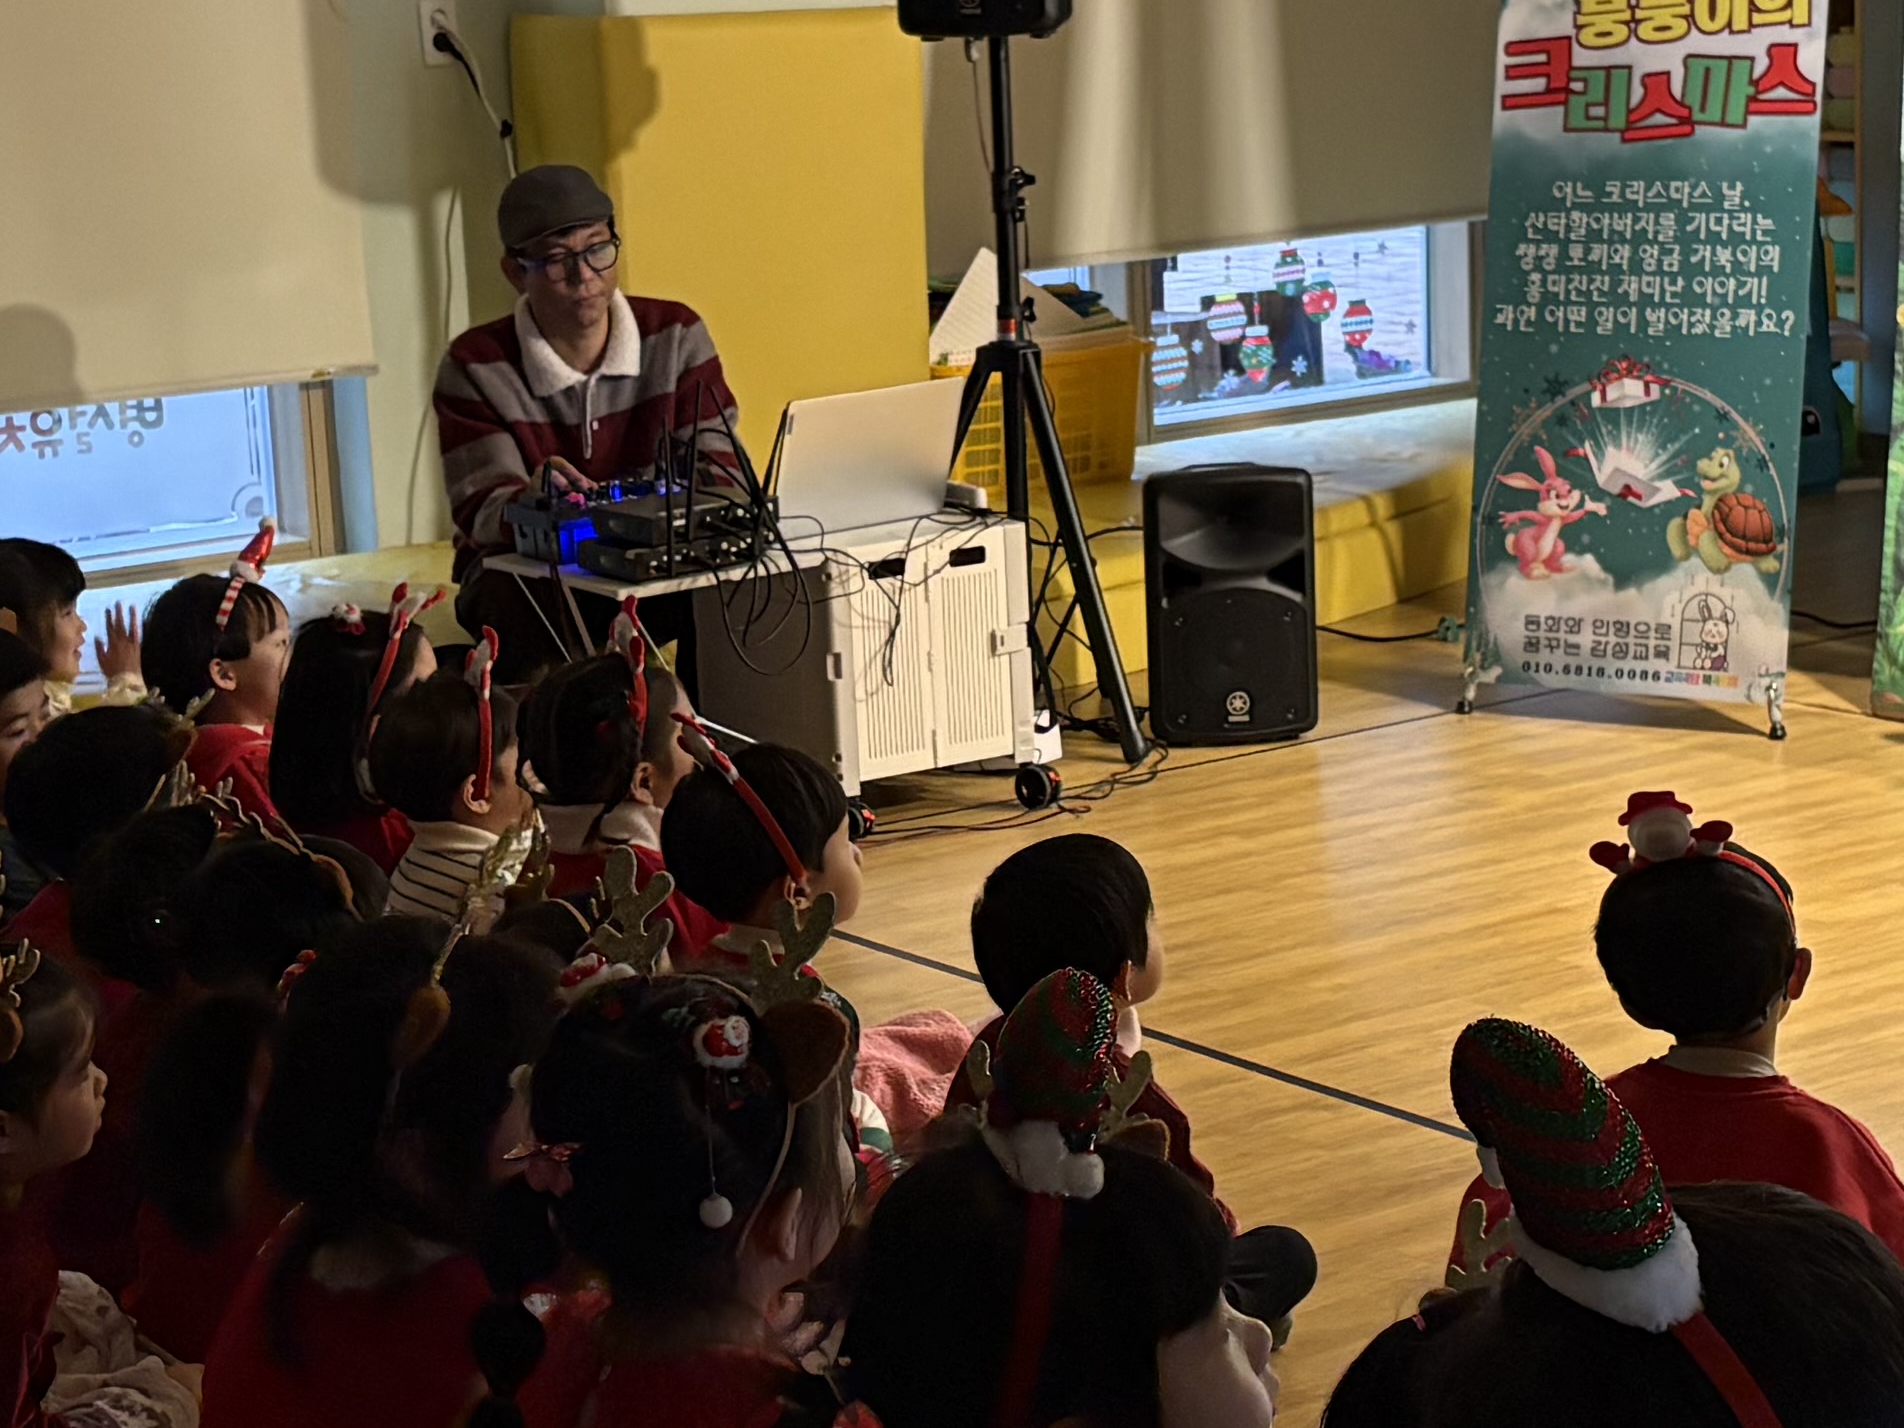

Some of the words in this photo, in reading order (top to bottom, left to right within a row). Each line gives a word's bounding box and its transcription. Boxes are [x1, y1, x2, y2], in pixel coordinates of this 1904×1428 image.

[1501, 36, 1817, 143] 크리스마스
[1552, 180, 1594, 208] 어느
[1601, 180, 1713, 209] 크리스마스
[1524, 210, 1678, 242] 산타할아버지를
[1685, 211, 1776, 242] 기다리는
[1564, 243, 1631, 272] 토끼와
[1638, 243, 1682, 272] 엉금
[1690, 243, 1780, 274] 거북이의
[1523, 272, 1610, 304] 흥미진진
[1617, 274, 1685, 303] 재미난
[1692, 274, 1768, 305] 이야기!
[1494, 304, 1536, 332] 과연
[1544, 305, 1587, 333] 어떤
[1594, 305, 1637, 335] 일이
[1644, 306, 1795, 338] 벌어졌을까요?
[1524, 614, 1585, 635] 동화와
[1592, 618, 1672, 641] 인형으로
